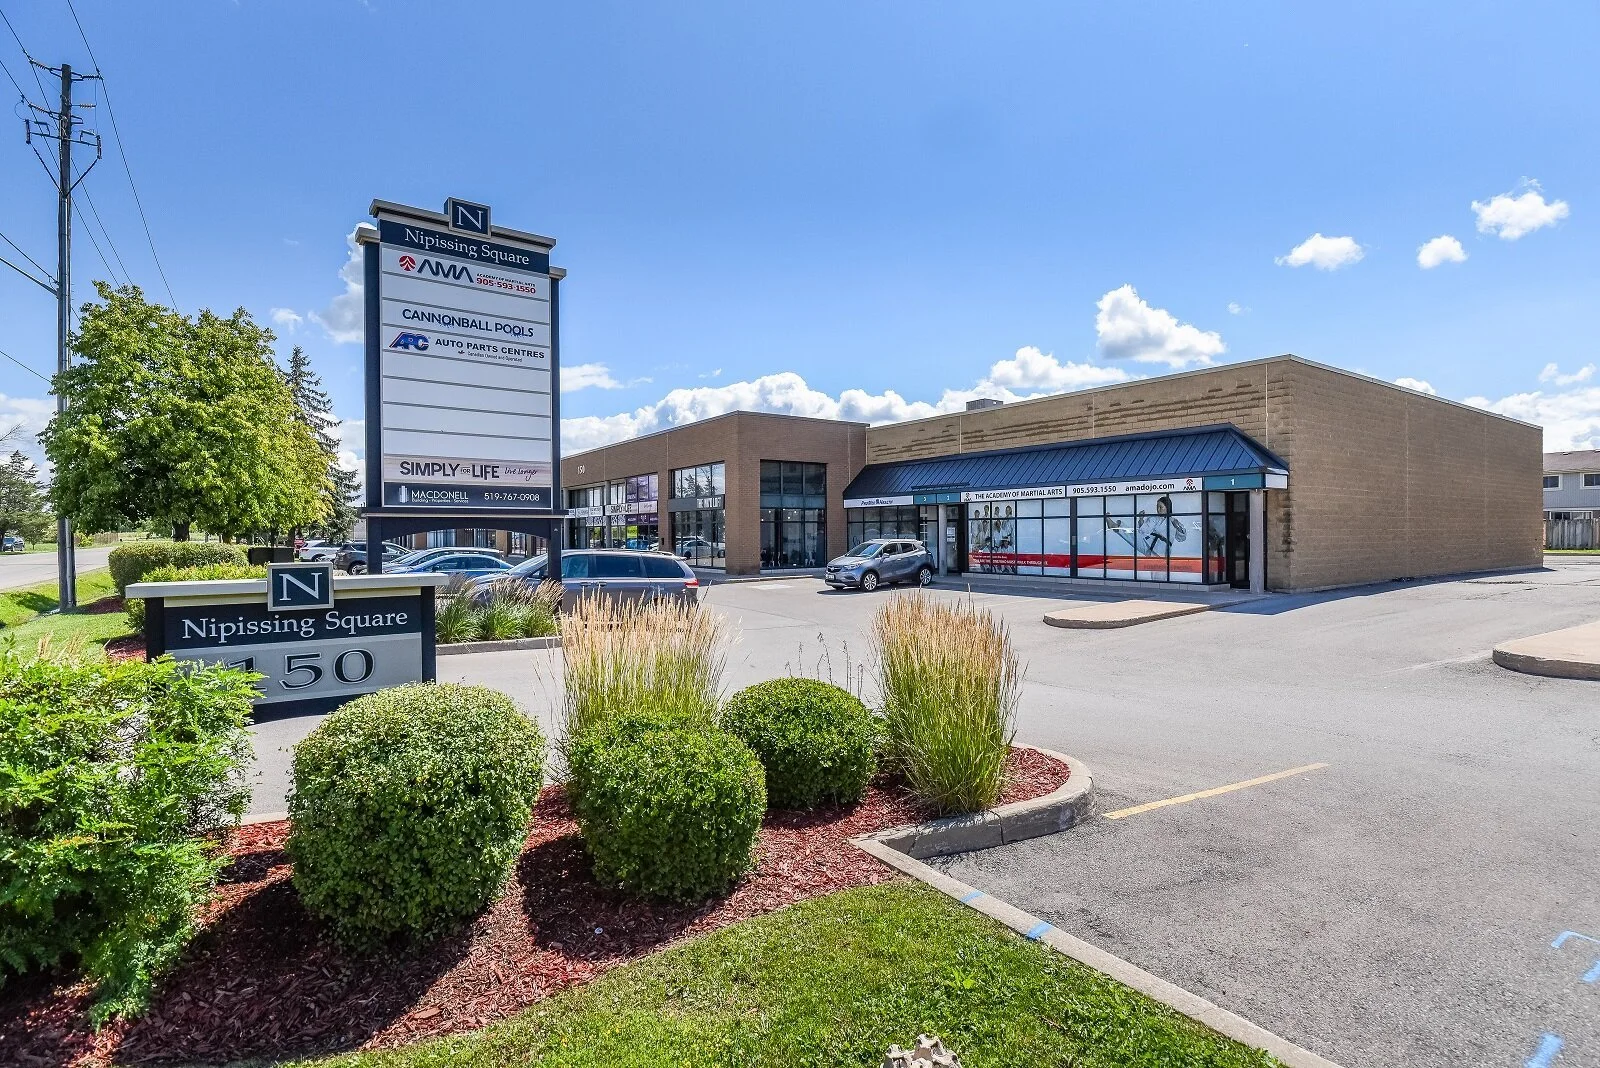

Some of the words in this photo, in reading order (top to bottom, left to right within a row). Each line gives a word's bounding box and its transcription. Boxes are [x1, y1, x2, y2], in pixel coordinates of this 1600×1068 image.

[456, 206, 483, 229] N
[405, 228, 477, 258] Nipissing
[482, 245, 529, 264] Square
[417, 259, 474, 283] AMA
[402, 309, 492, 331] CANNONBALL
[495, 322, 533, 337] POOLS
[435, 338, 463, 348] AUTO
[466, 342, 498, 352] PARTS
[501, 347, 545, 358] CENTRES
[400, 461, 460, 477] SIMPLY
[472, 464, 499, 480] LIFE
[577, 465, 585, 474] 150
[1073, 485, 1117, 494] 905.593.1550
[1125, 482, 1175, 492] amadojo.com
[1230, 478, 1235, 486] 1
[412, 490, 469, 499] MACDONELL
[484, 493, 540, 501] 519-767-0908
[985, 491, 1012, 499] ACADEMY
[1012, 490, 1020, 498] OF
[1020, 489, 1046, 497] MARTIAL
[1047, 488, 1063, 496] ARTS
[278, 572, 322, 601] N
[182, 614, 315, 643] Nipissing
[325, 611, 408, 634] Square
